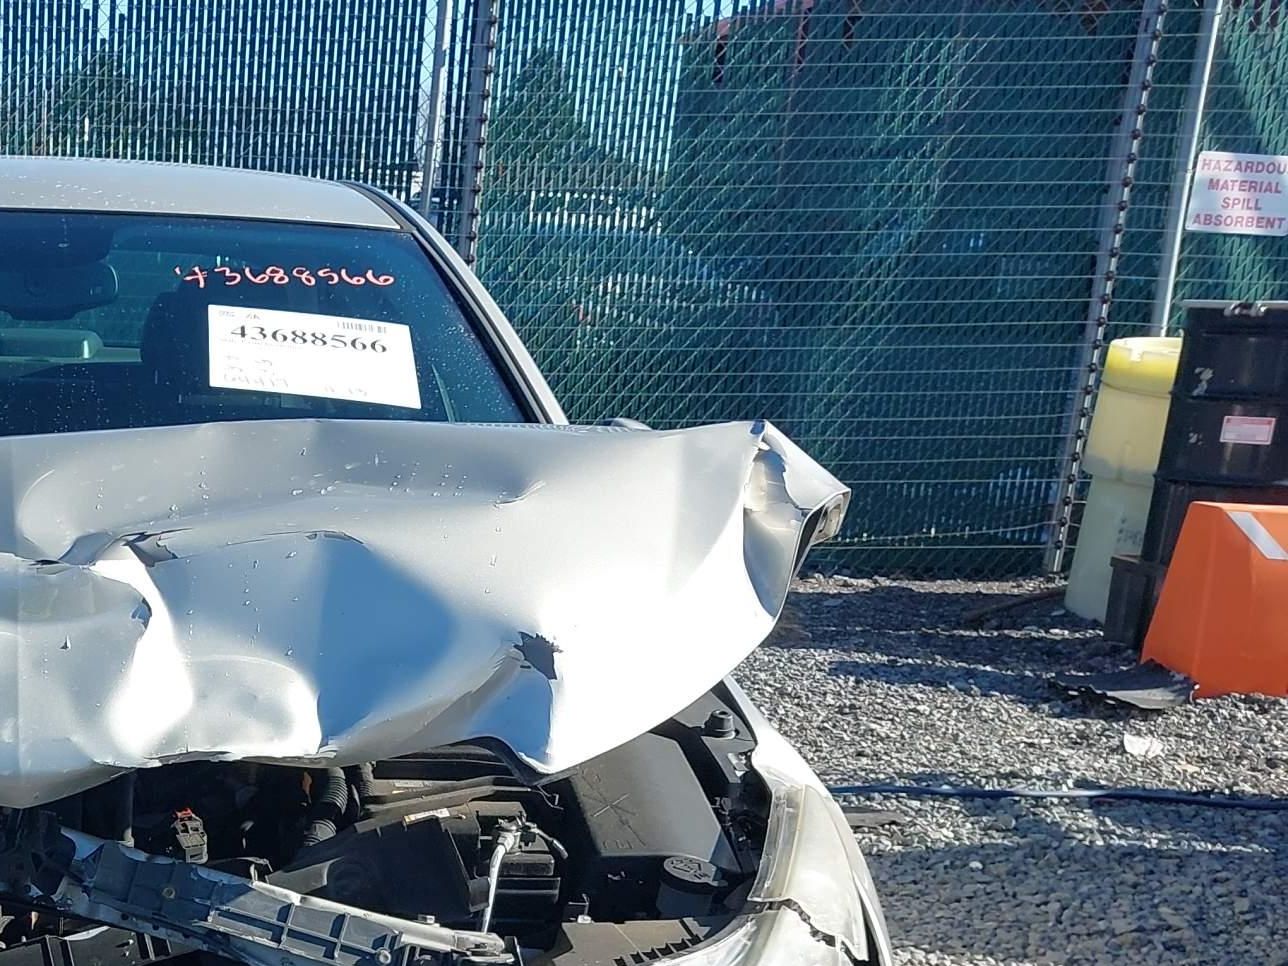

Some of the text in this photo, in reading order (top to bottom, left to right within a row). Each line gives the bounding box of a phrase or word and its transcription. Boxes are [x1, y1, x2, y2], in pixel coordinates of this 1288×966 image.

[1201, 158, 1288, 175] HAZARDOU
[1207, 178, 1283, 194] MATERIAL
[1221, 196, 1263, 211] SPILL
[1192, 213, 1286, 229] ABSORBENT
[230, 324, 387, 354] 43688566
